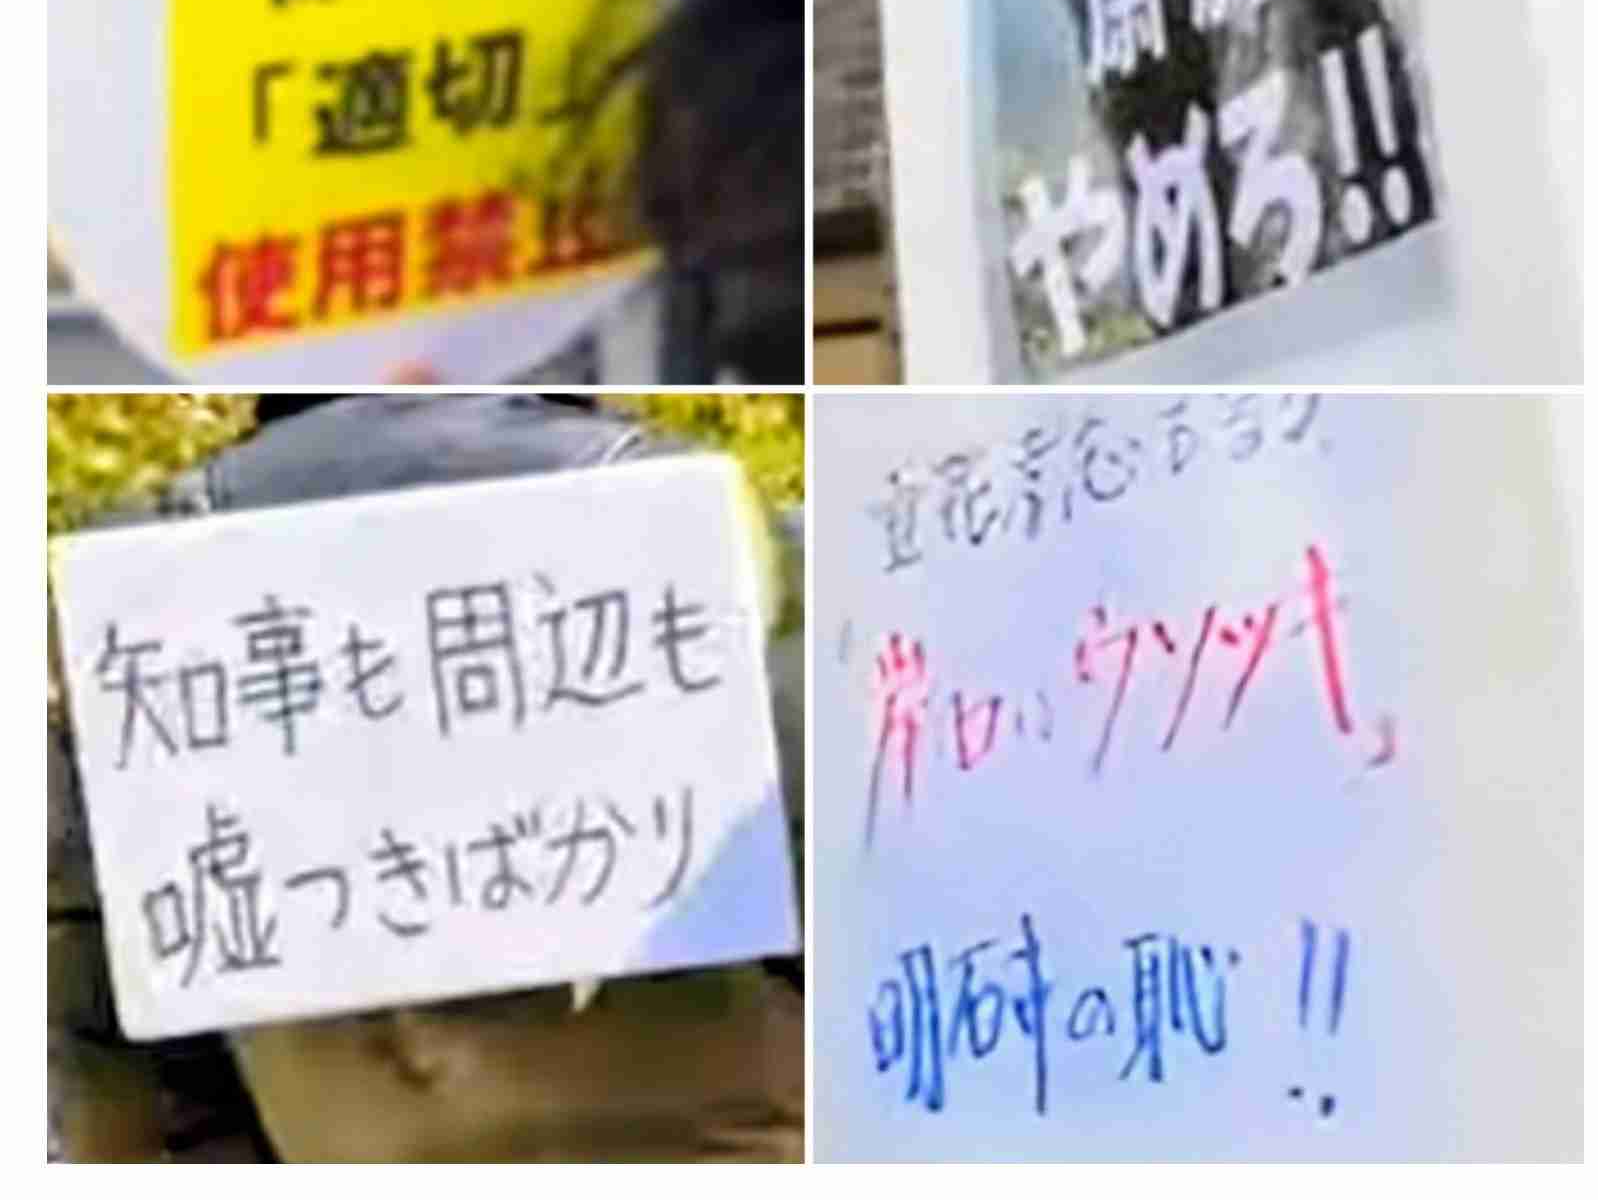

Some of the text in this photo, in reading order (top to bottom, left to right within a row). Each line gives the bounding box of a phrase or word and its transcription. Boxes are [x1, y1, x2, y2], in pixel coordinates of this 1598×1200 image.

[96, 572, 722, 771] 知事も周辺も
[142, 786, 698, 988] 嘘つきばかり
